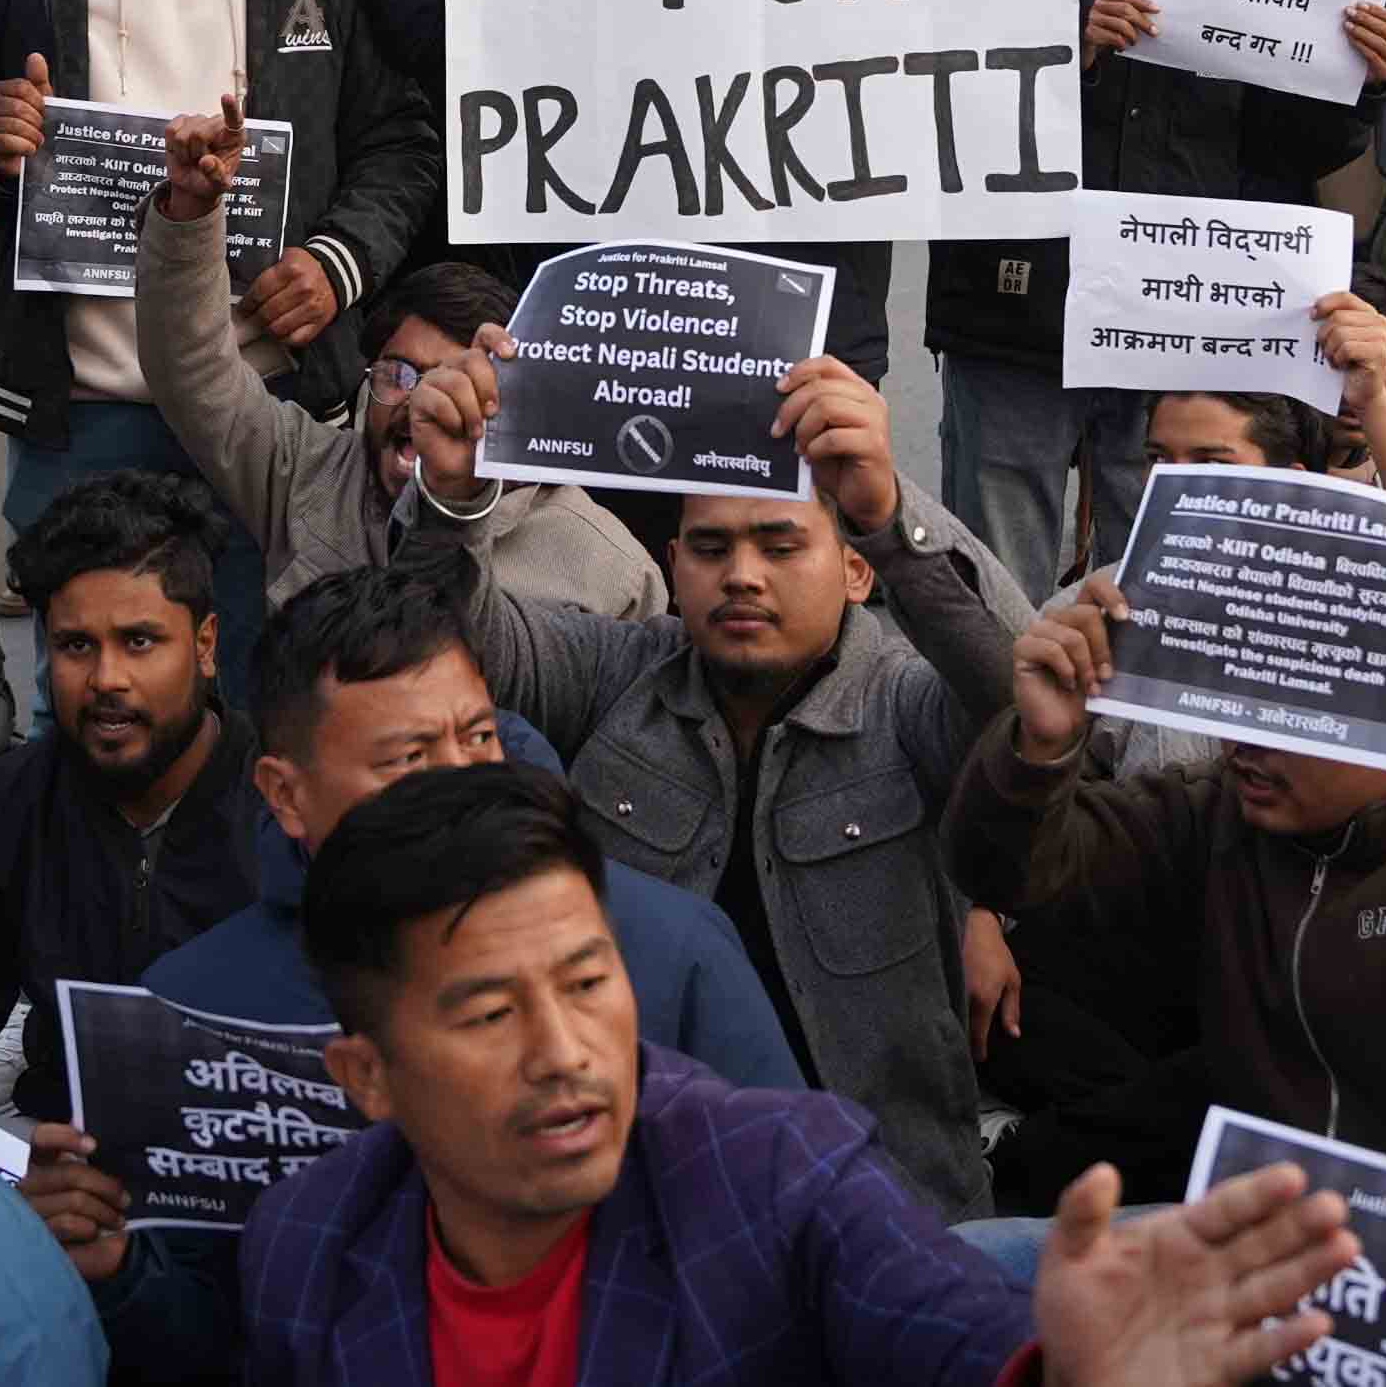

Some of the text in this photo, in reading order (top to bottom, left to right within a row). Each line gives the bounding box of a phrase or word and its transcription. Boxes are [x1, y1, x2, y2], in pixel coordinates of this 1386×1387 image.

[1201, 25, 1313, 64] बन्द गर !!!
[57, 122, 111, 141] Justice
[115, 130, 138, 145] for
[458, 44, 1079, 216] PRAKRITI
[1120, 214, 1313, 261] नेपाली विद्यार्थी
[83, 268, 131, 280] ANNFSU
[597, 252, 728, 272] Justice for Prakriti Lamsal
[575, 272, 735, 305] Stop Threats,
[1142, 274, 1285, 309] माथी भएको
[559, 304, 739, 337] Stop Violence!
[598, 343, 678, 372] Nepali
[1091, 327, 1195, 354] आक्रमण
[1202, 336, 1255, 357] बन्द
[1261, 338, 1300, 358] गर
[593, 380, 692, 409] Abroad!
[527, 437, 593, 456] ANNFSU
[1175, 493, 1238, 514] Justice
[1240, 500, 1271, 519] for
[1275, 502, 1356, 532] Prakriti
[1216, 538, 1326, 570] -KIIT Odisha
[1178, 692, 1245, 717] ANNFSU
[184, 1050, 348, 1110] अविलम्ब
[144, 1145, 270, 1185] सम्बाद
[145, 1191, 226, 1213] ANNFSU
